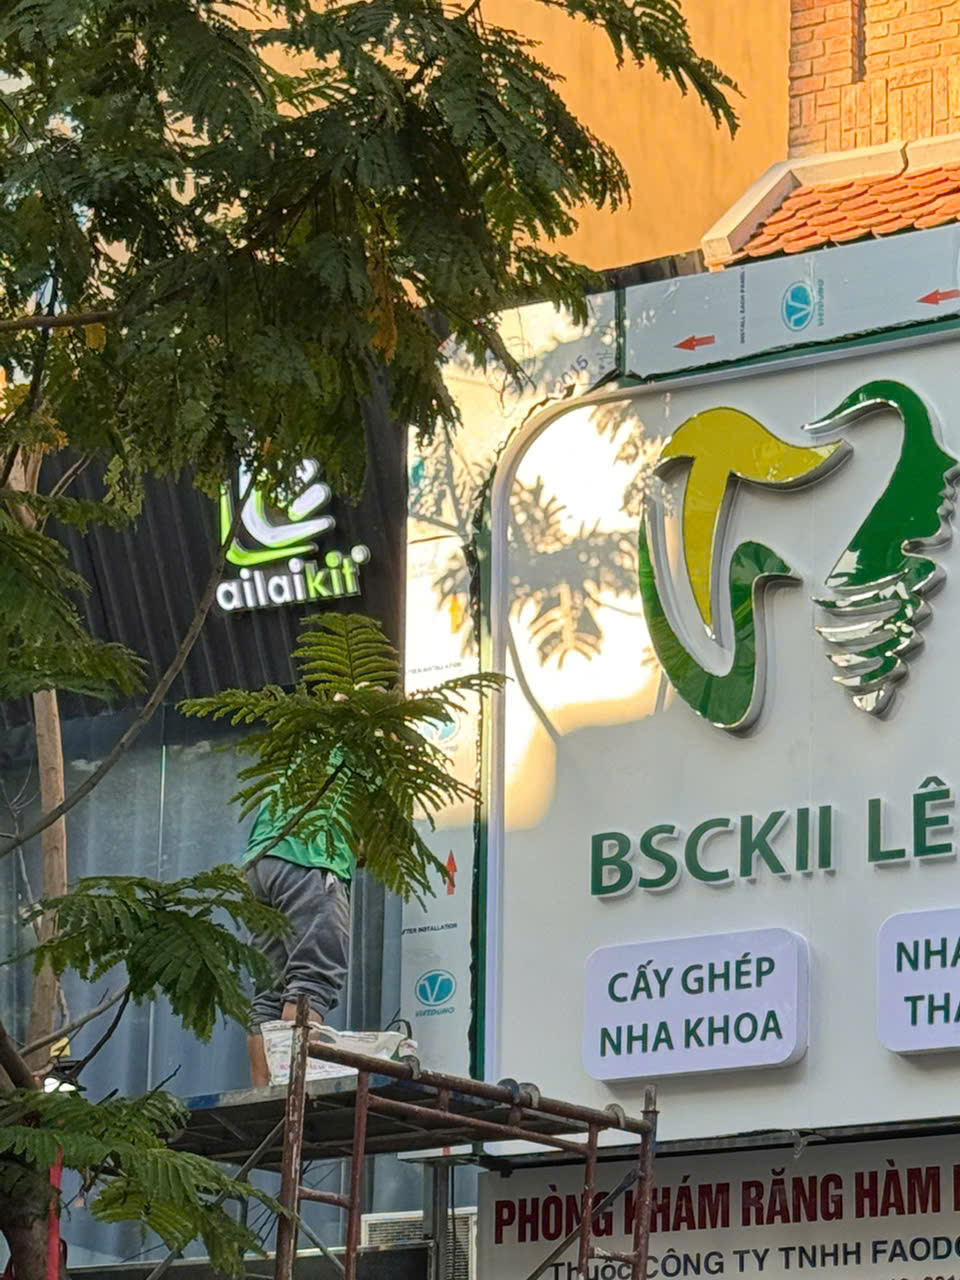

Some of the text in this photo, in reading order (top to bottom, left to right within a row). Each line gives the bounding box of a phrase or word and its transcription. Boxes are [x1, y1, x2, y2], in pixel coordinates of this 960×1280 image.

[216, 548, 362, 611] ailaikit
[590, 804, 833, 897] BSCKII
[867, 776, 955, 864] LÊ
[608, 951, 776, 1003] CẤY GHÉP
[600, 1009, 783, 1057] NHA KHOA
[741, 1167, 844, 1227] RĂNG
[855, 1158, 942, 1219] HÀM
[732, 1248, 771, 1273] TY
[778, 1241, 861, 1270] TNHH
